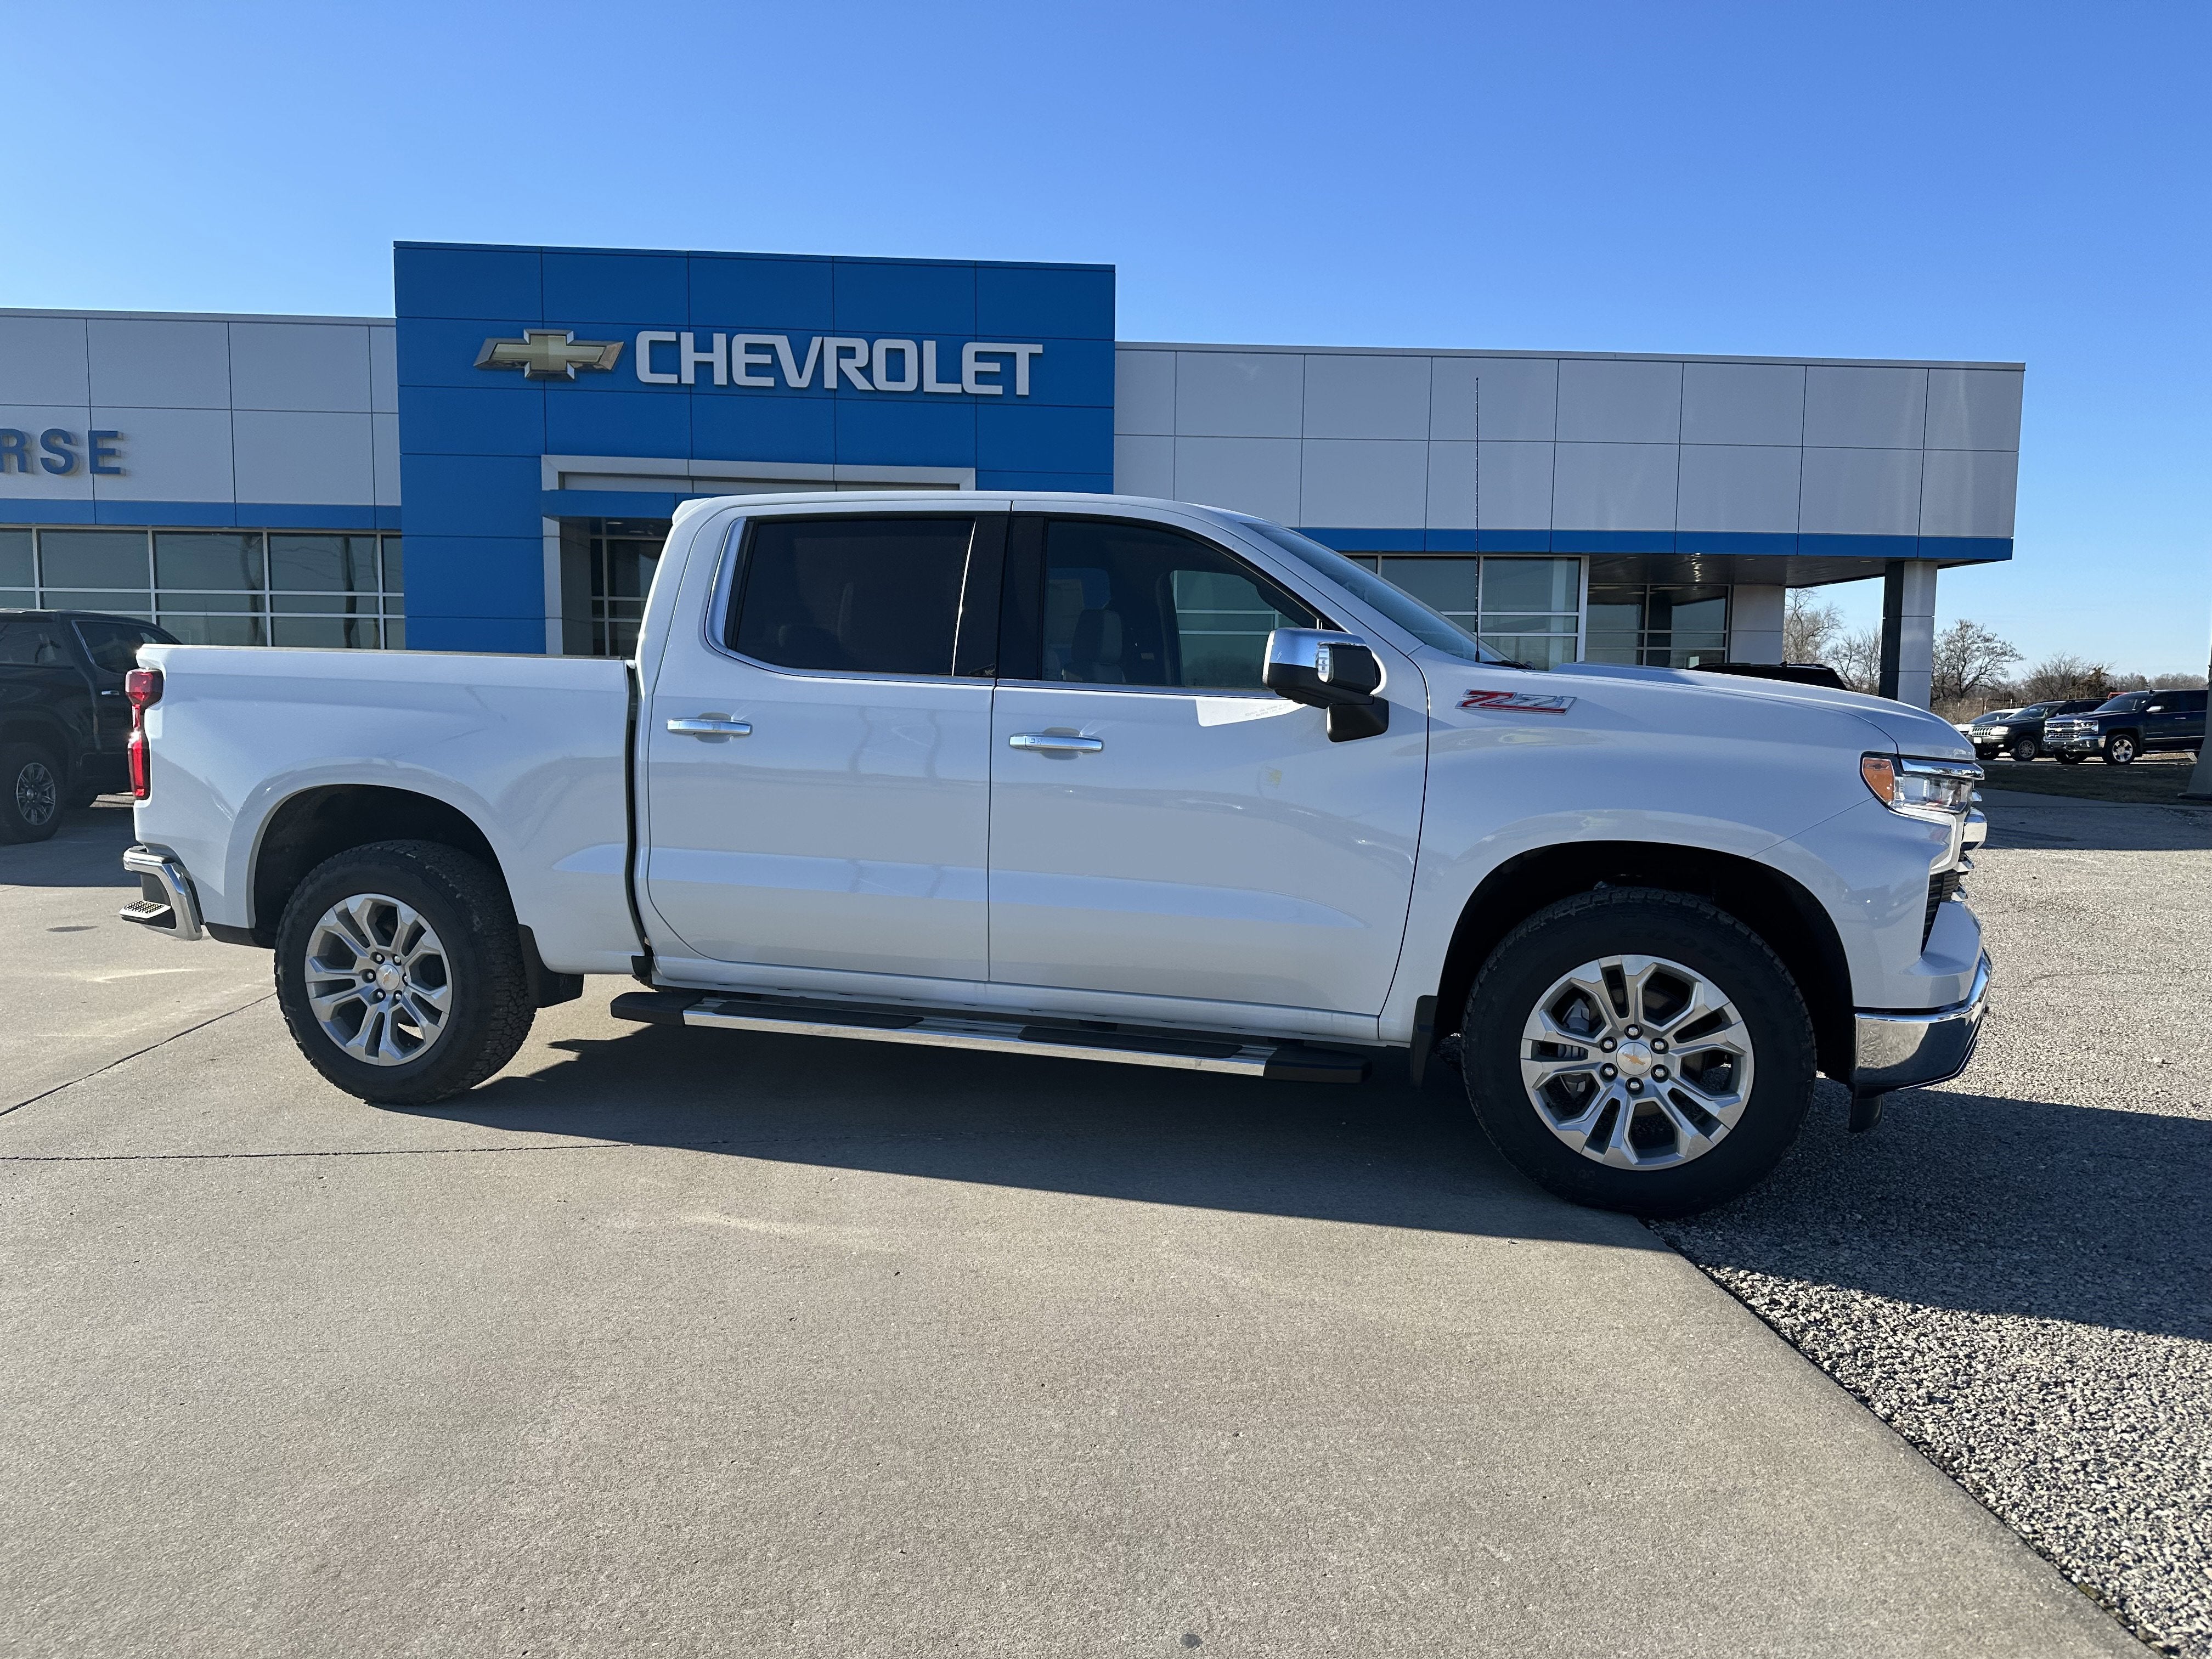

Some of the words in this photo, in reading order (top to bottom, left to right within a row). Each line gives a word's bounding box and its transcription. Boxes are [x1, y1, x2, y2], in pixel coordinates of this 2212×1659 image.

[636, 330, 1043, 396] CHEVROLET
[0, 428, 123, 475] RSE
[1454, 689, 1578, 715] Z71
